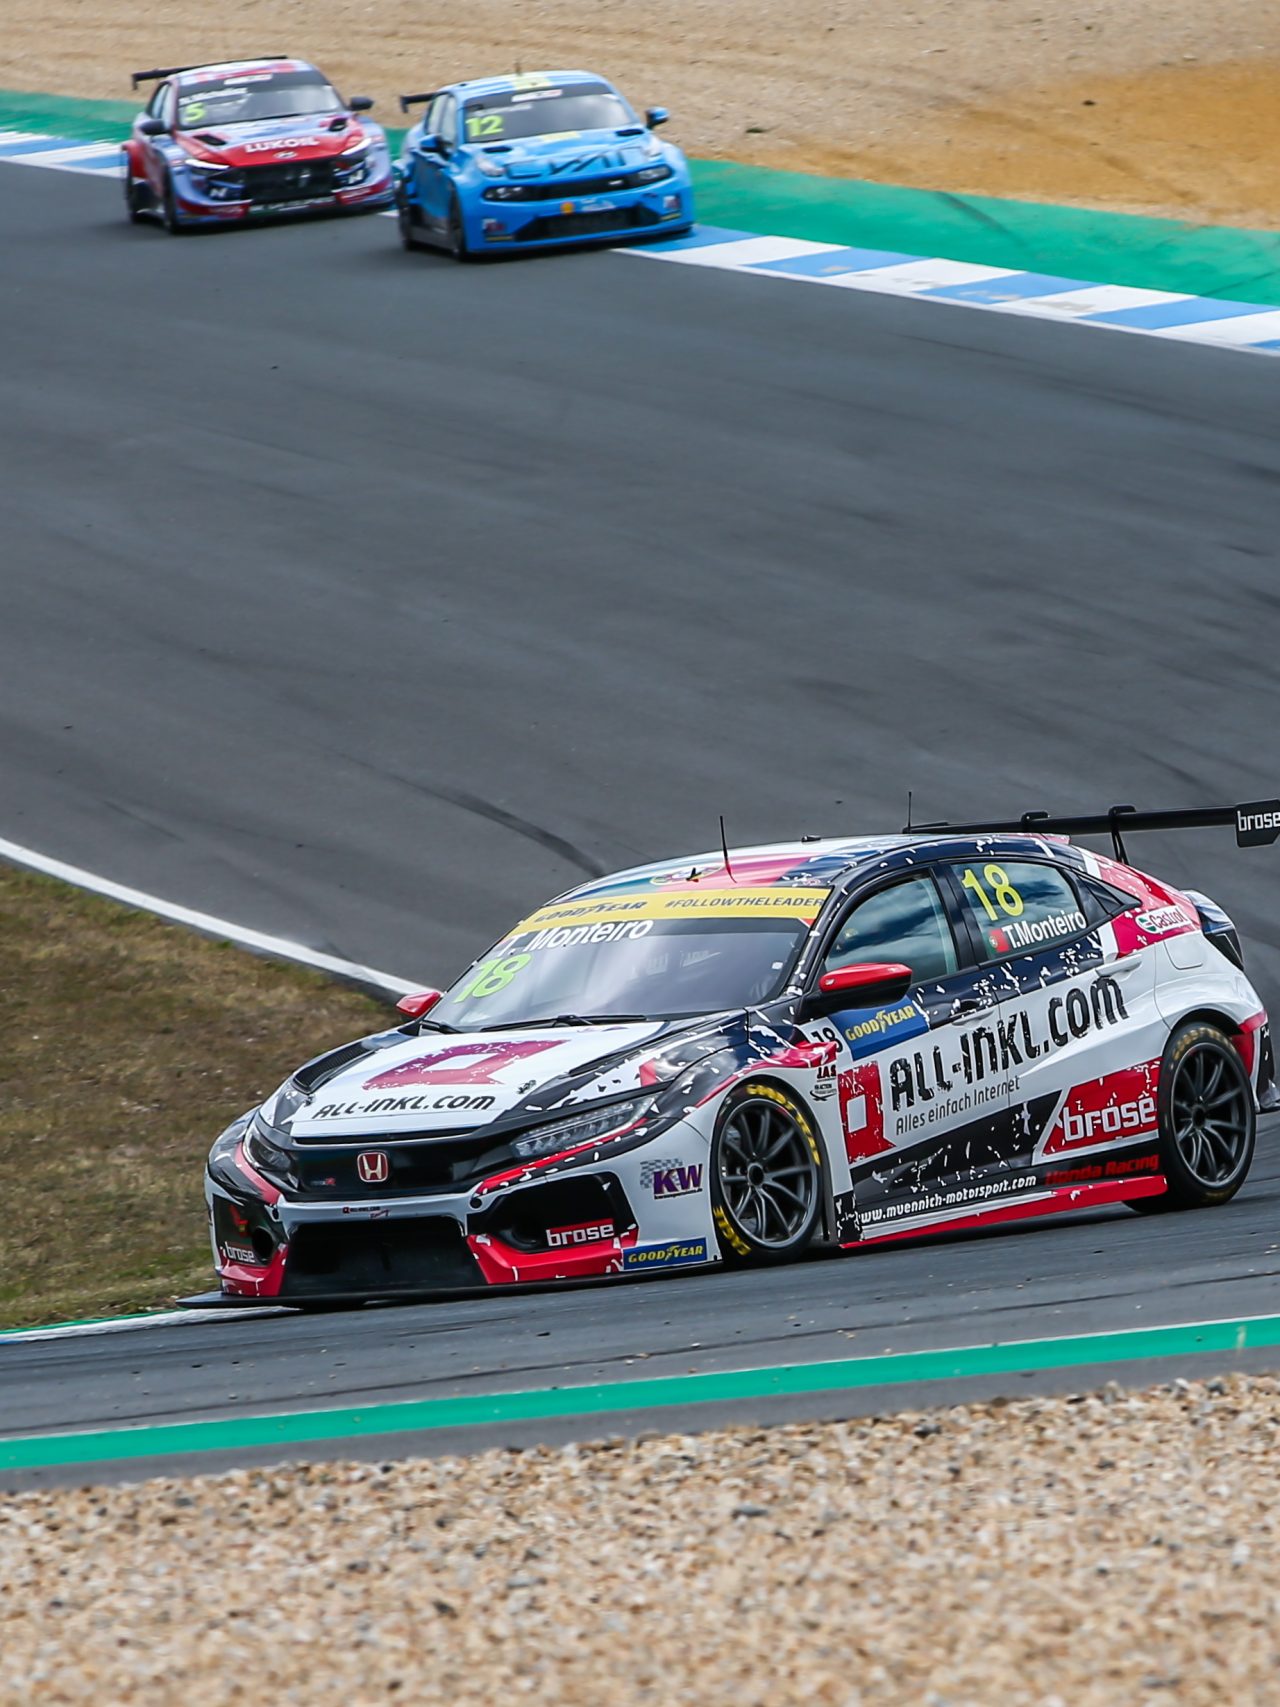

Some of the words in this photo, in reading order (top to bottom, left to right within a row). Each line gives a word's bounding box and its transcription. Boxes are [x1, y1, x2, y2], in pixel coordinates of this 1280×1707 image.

[185, 102, 206, 122] 5
[465, 115, 505, 137] 12
[245, 137, 321, 153] LUKOIL
[961, 863, 1025, 921] 18
[534, 901, 648, 923] GOODYEAR
[664, 896, 825, 908] #FOLLOWTHELEADER
[1150, 907, 1189, 930] Castrol
[498, 933, 529, 957] T.
[523, 919, 655, 952] Monteiro
[1001, 910, 1088, 950] T.Monteiro
[452, 952, 533, 1004] 18
[844, 1004, 917, 1041] GOODYEAR
[895, 1112, 926, 1137] Alles
[927, 1089, 972, 1122] einfach
[973, 1075, 1021, 1107] Internet
[1062, 1096, 1157, 1142] brose
[653, 1163, 704, 1195] KW
[1044, 1162, 1102, 1186] Honda
[1104, 1153, 1160, 1176] Racing
[545, 1223, 615, 1248] brose
[224, 1241, 256, 1264] brose
[628, 1244, 705, 1264] GOODYEAR
